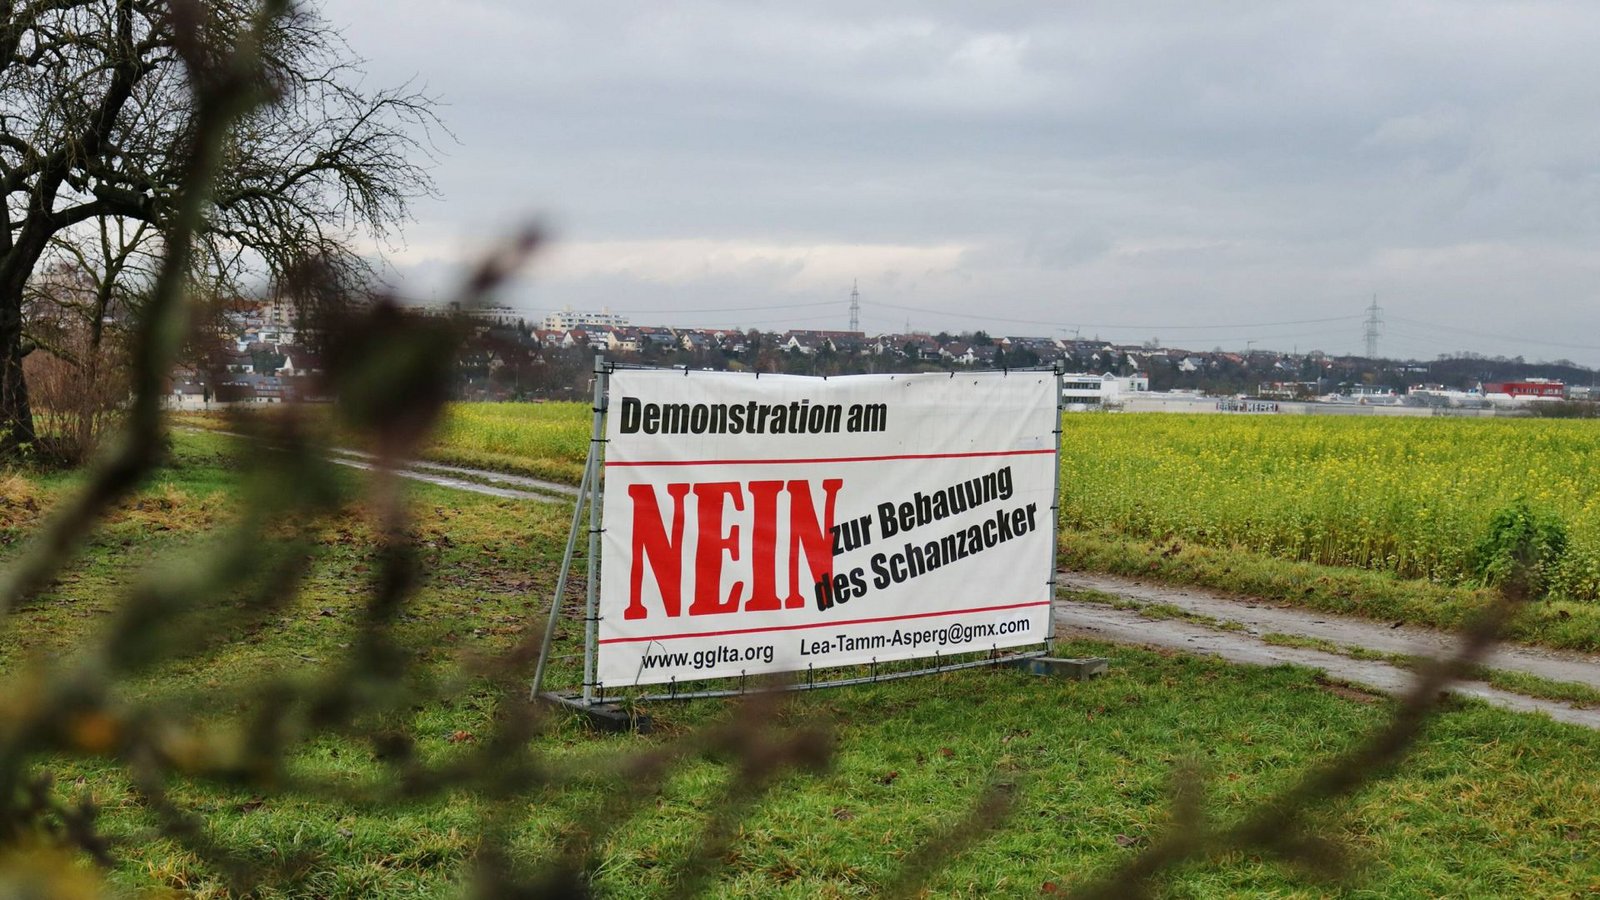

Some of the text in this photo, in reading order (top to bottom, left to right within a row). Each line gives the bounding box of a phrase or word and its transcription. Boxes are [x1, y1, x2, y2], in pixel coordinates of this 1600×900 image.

[620, 397, 887, 435] Demonstration am
[829, 466, 1013, 557] zur Bebauung
[624, 478, 844, 620] NEIN
[814, 503, 1038, 612] des Schanzacker
[642, 645, 774, 669] www.gglta.org
[800, 618, 1030, 656] Lea-Tamm-Asperg@gmx.com
